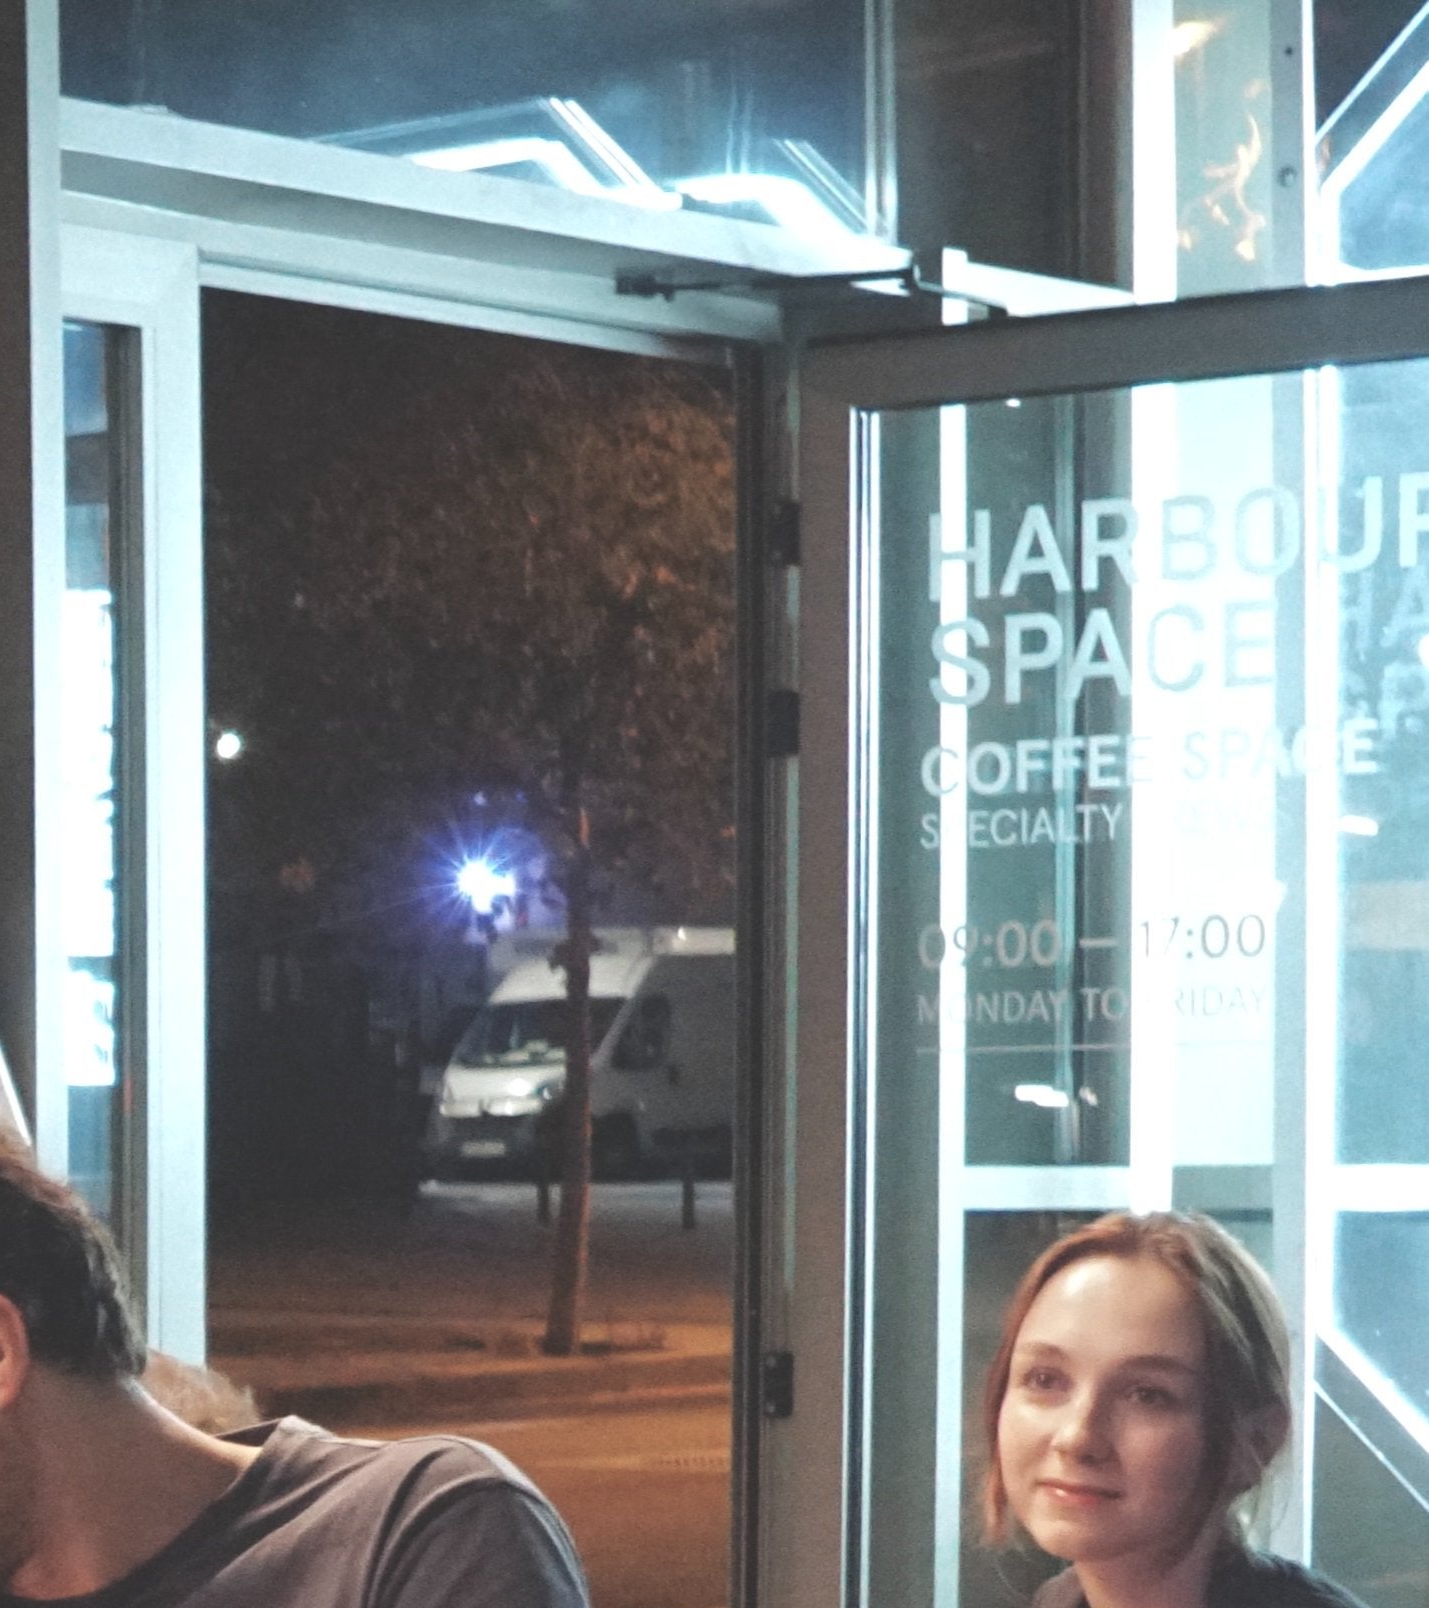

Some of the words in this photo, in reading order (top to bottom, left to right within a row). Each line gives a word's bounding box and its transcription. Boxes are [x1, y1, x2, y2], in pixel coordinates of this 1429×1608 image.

[928, 600, 1276, 707] SPACE
[920, 734, 1153, 797] COFFEE
[1182, 718, 1379, 782] SPACE
[920, 803, 1124, 850] SPECIALTY
[918, 919, 1061, 970] 09:00
[1141, 914, 1266, 960] 17:00
[915, 987, 1069, 1025] MONDAY
[1081, 987, 1125, 1021] TO
[1160, 983, 1267, 1017] RIDAY
